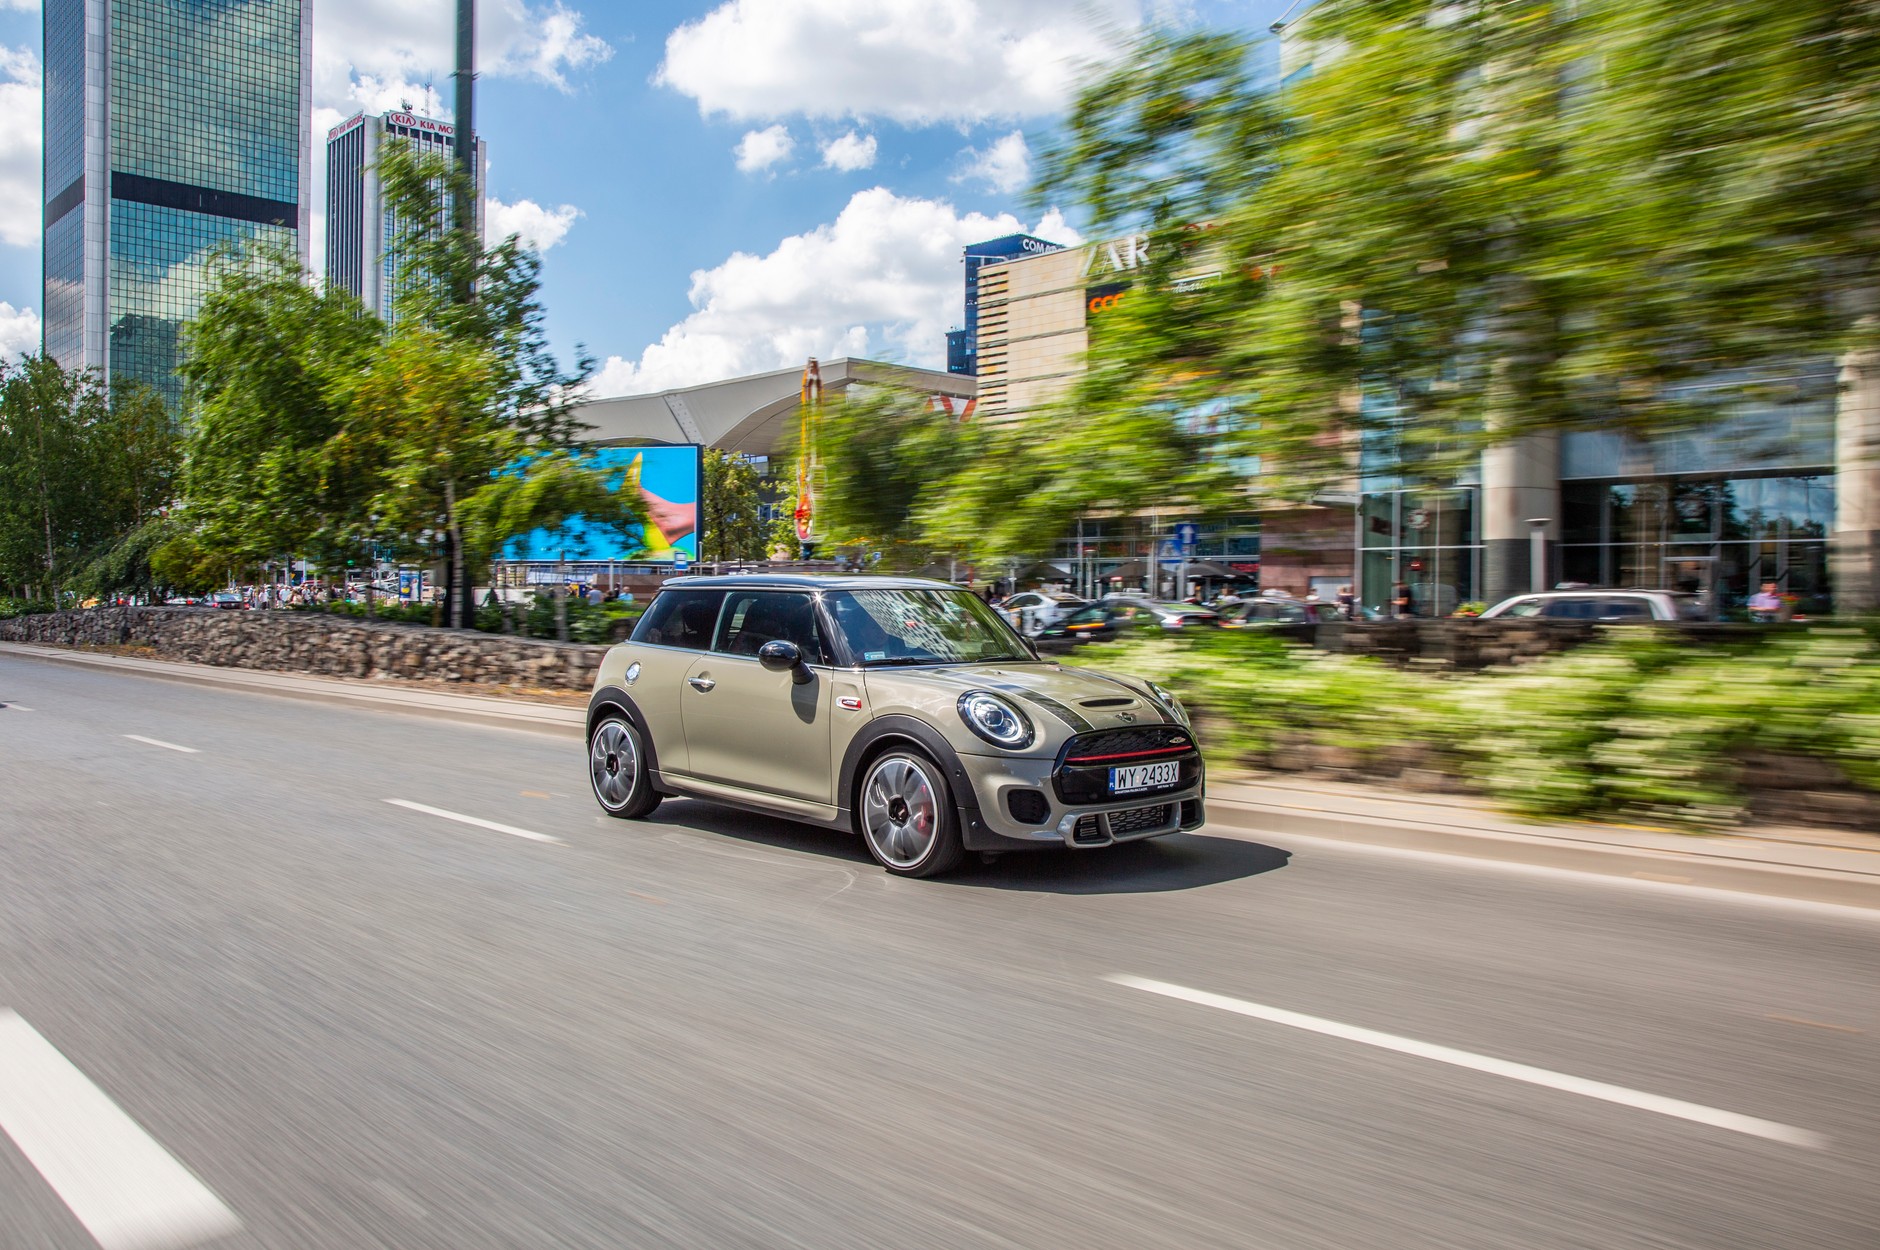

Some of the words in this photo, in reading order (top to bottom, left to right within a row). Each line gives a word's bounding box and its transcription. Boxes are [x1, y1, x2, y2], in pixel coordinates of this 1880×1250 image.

[396, 115, 412, 125] KIA
[420, 120, 436, 131] KIA
[1118, 768, 1136, 788] WY
[1141, 763, 1177, 785] 2433X
